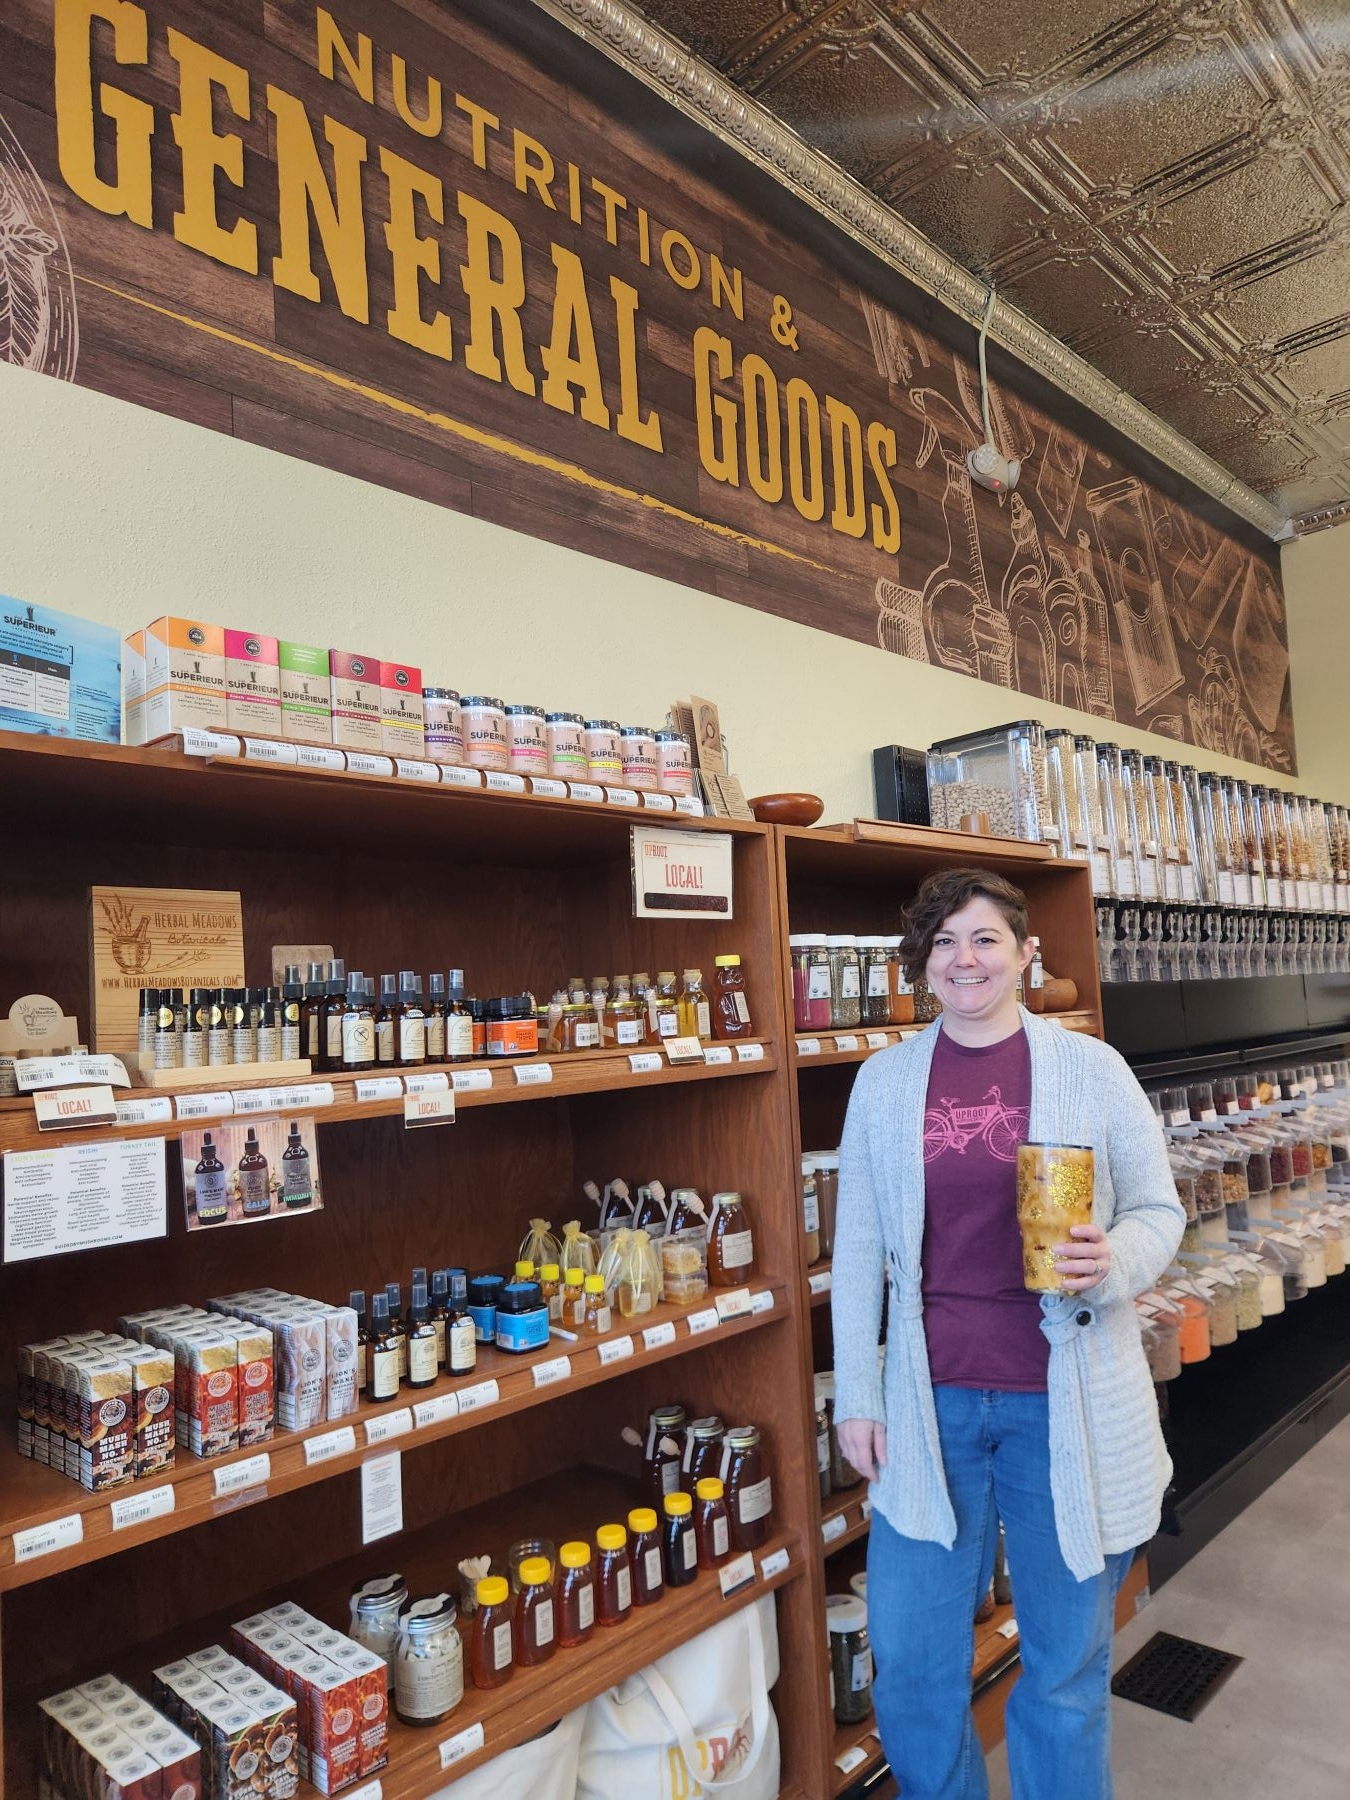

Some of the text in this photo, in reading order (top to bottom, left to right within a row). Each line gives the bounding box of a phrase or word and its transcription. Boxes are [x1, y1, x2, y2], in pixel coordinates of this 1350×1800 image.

[317, 8, 801, 352] NUTRITION &
[54, 0, 902, 555] GENERAL GOODS
[4, 615, 56, 636] SUPERIEUR
[170, 670, 224, 687] SUPERIEUR
[228, 680, 279, 696] SUPERIEUR
[282, 691, 329, 706] SUPERIEUR
[336, 698, 379, 713] SUPERIEUR
[382, 708, 422, 721] SUPERIEUR
[644, 844, 668, 858] UPROOT
[664, 864, 703, 889] LOCAL!
[154, 912, 237, 929] HERBAL MEADOWS
[168, 934, 228, 944] Botanicals
[56, 1099, 92, 1116] LOCAL!
[418, 1101, 441, 1116] LOCAL!
[956, 1108, 988, 1120] UPROOT
[198, 1206, 227, 1218] FOCUS
[144, 1420, 170, 1433] MUSH
[144, 1426, 170, 1440] MASH
[99, 1432, 127, 1446] MUSH
[146, 1438, 162, 1447] NO.
[99, 1440, 128, 1454] MASH
[102, 1451, 118, 1460] NO.
